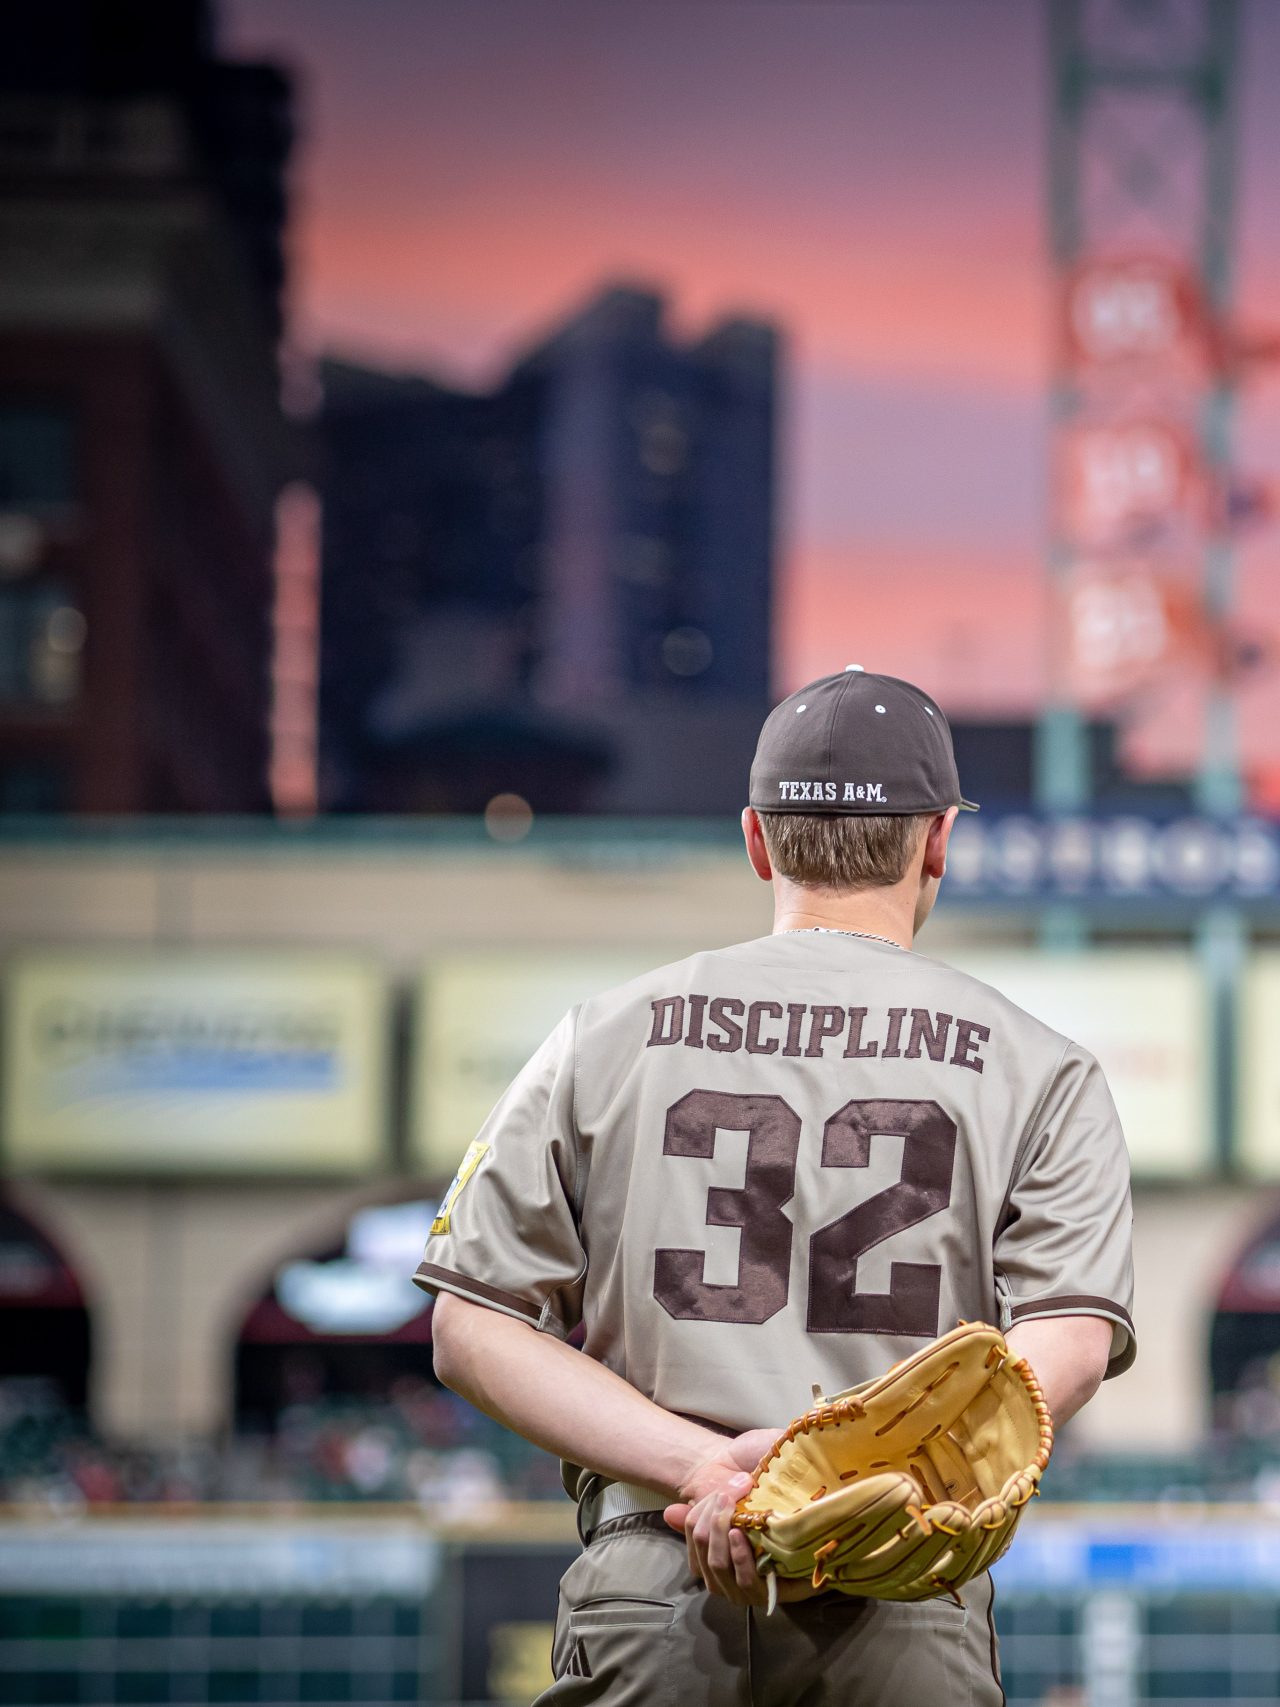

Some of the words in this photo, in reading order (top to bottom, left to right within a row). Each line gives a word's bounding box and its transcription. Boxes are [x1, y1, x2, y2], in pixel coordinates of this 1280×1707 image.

[779, 782, 837, 801] TEXAS
[647, 994, 991, 1074] DISCIPLINE
[653, 1088, 958, 1338] 32
